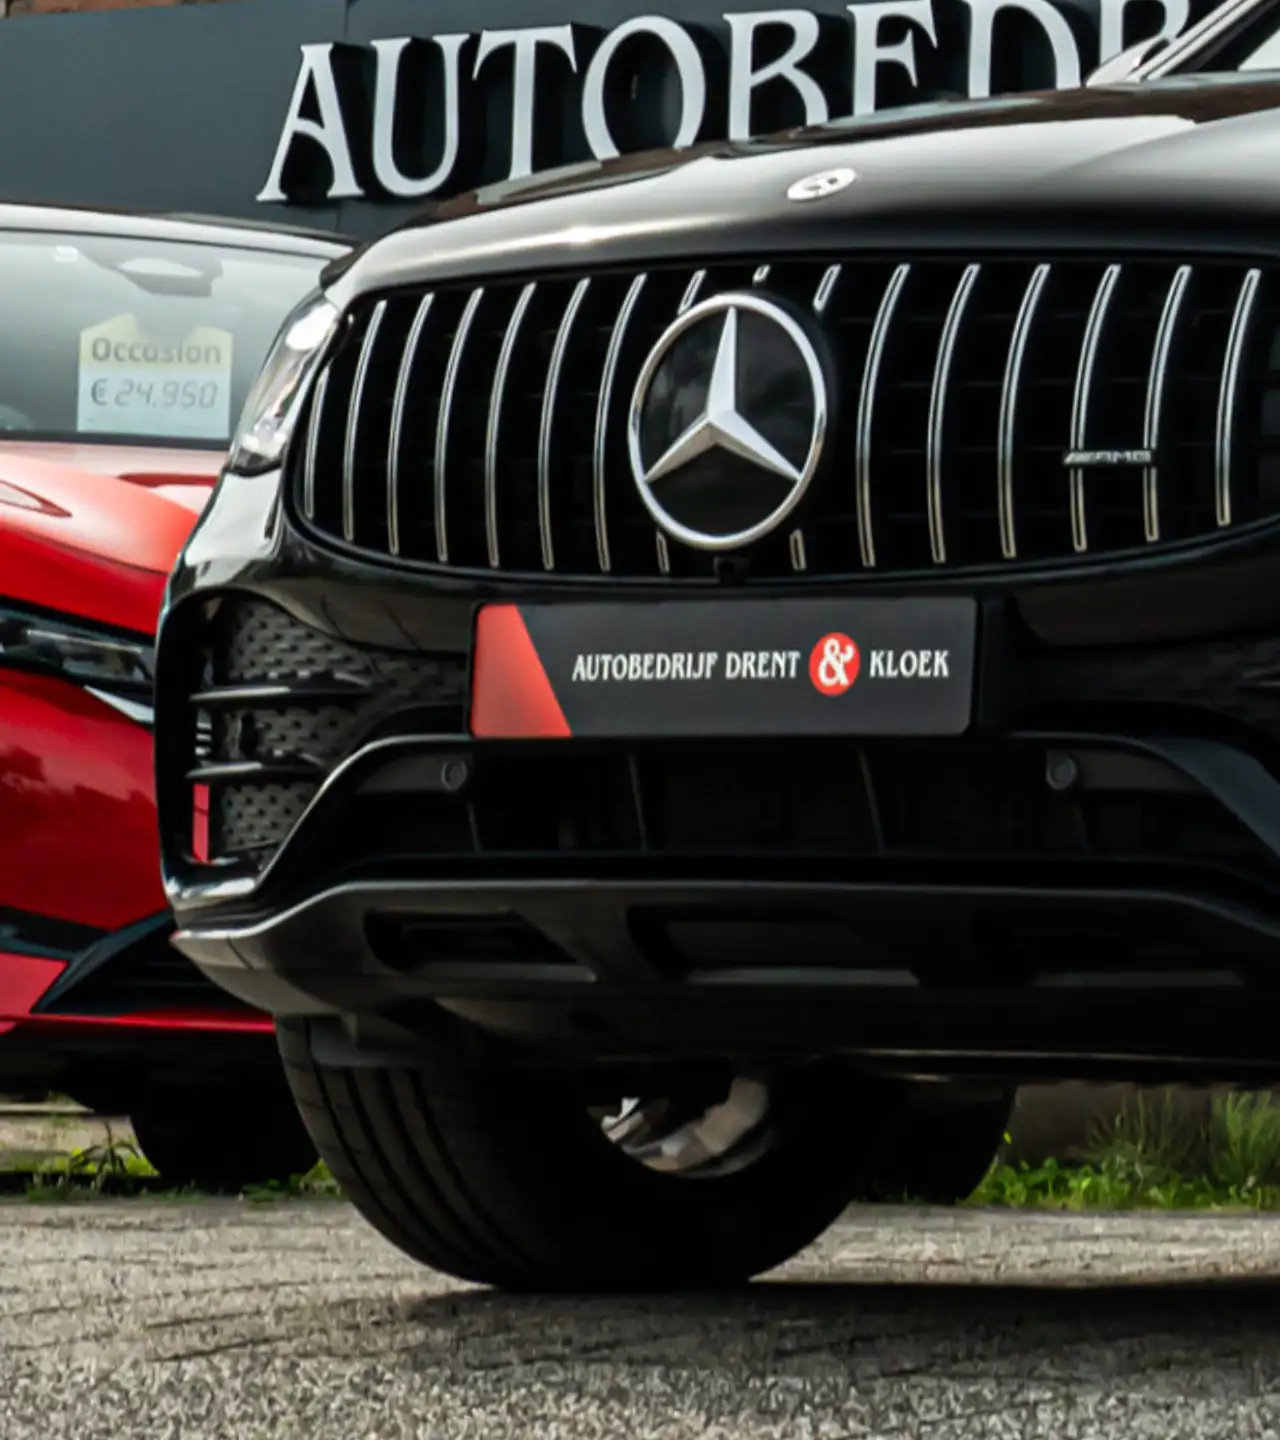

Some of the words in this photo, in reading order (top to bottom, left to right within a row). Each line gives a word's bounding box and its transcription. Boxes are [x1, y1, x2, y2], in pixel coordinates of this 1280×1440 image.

[91, 336, 222, 365] Occasion
[113, 378, 218, 409] 24.950
[571, 651, 719, 682] AUTOBEDRIJF
[724, 650, 801, 680] DRENT
[817, 637, 854, 688] &
[868, 649, 951, 678] KLOEK
